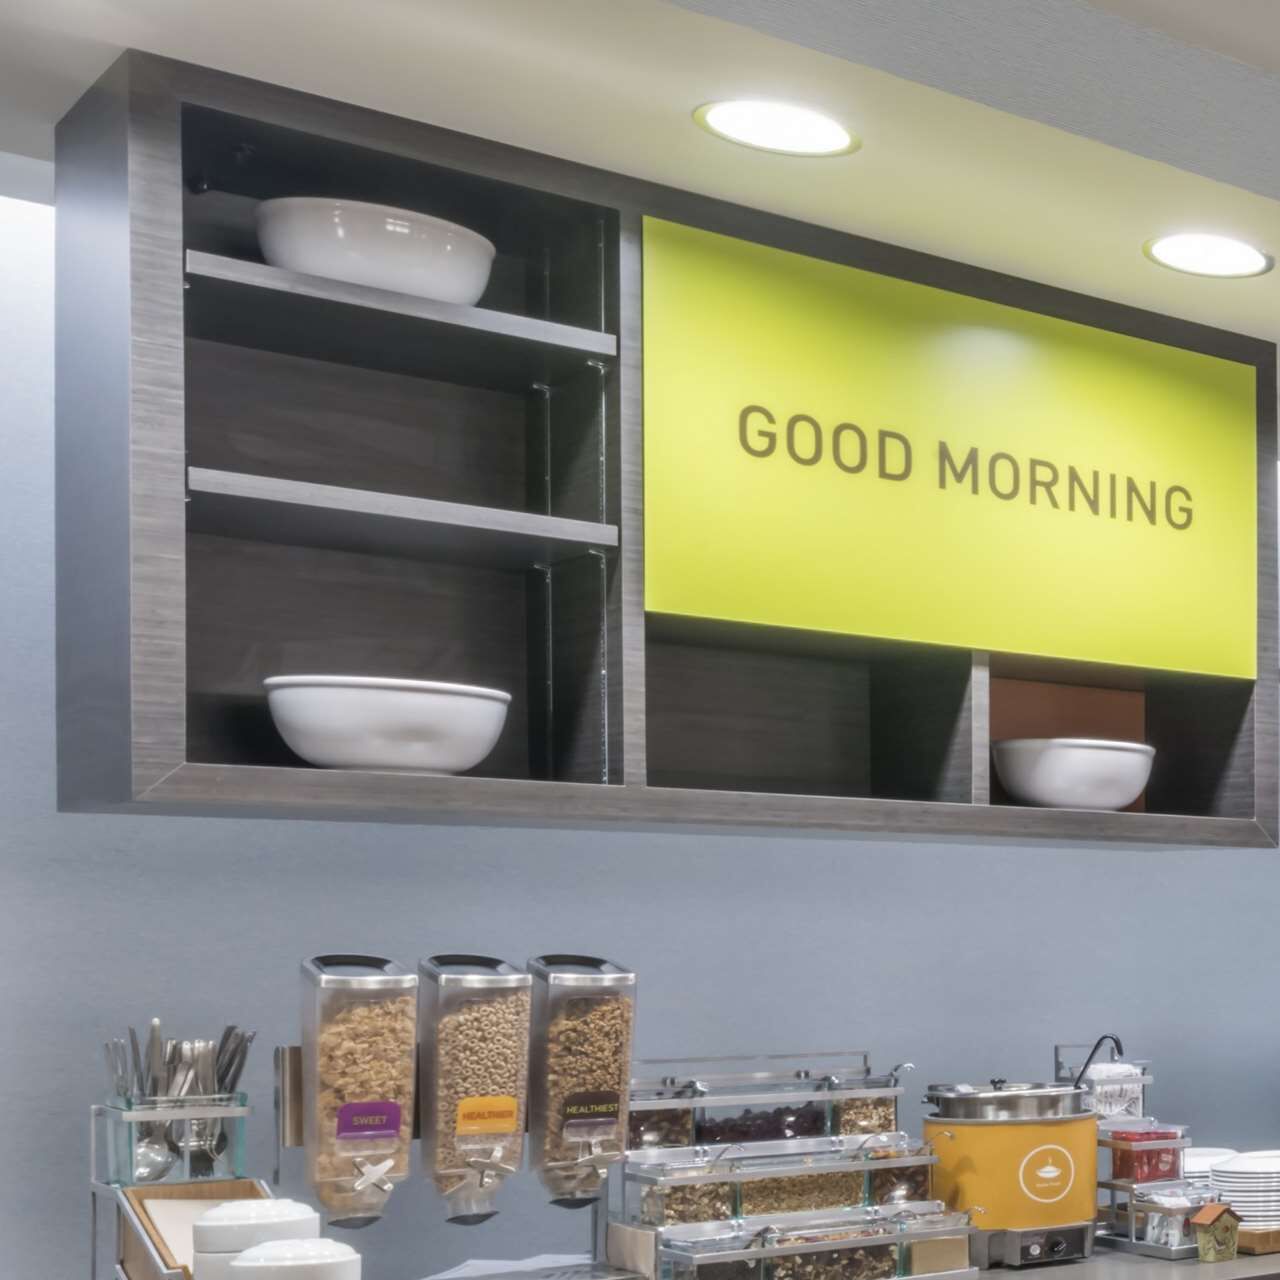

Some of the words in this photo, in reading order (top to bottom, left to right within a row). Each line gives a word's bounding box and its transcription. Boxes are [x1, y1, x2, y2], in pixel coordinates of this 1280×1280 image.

[738, 404, 914, 482] GOOD
[937, 440, 1195, 532] MORNING
[566, 1102, 619, 1115] HEALTHIEST
[352, 1114, 387, 1126] SWEET
[462, 1109, 514, 1121] HEALTHIER
